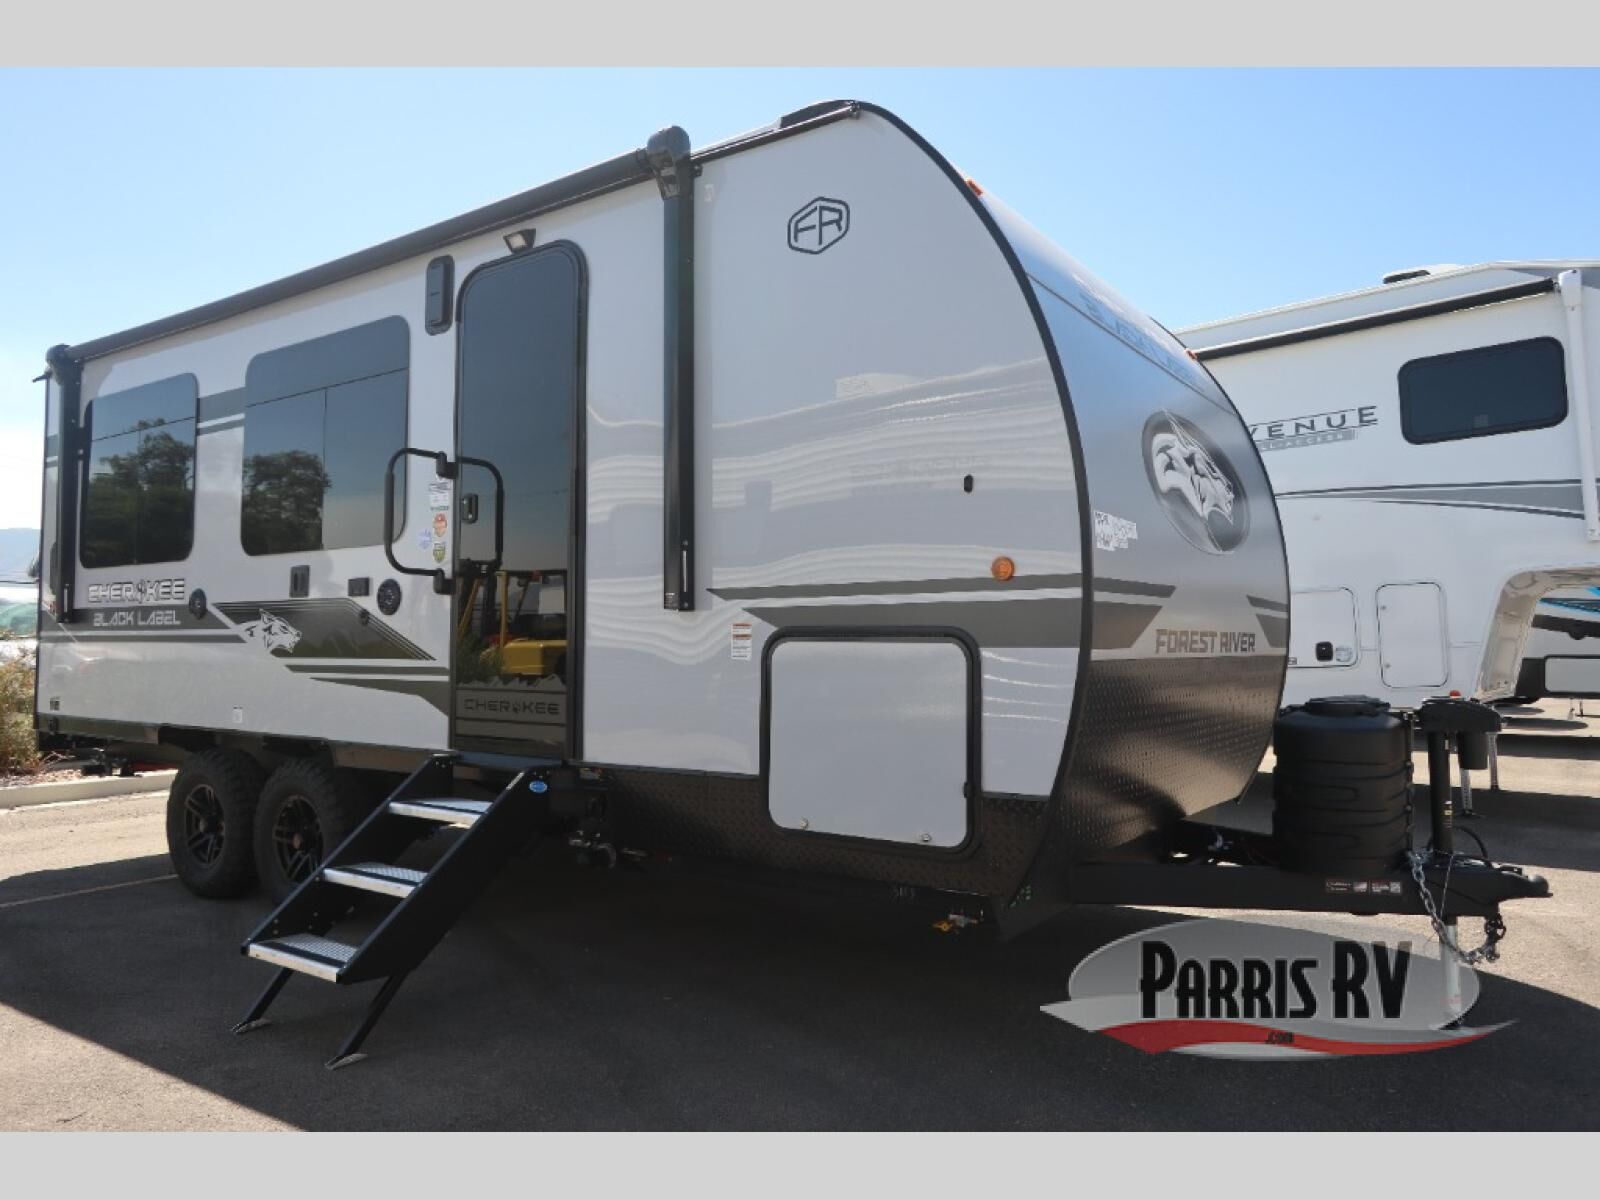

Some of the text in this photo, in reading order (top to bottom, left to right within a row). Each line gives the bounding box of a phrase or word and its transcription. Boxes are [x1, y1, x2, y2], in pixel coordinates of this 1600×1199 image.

[93, 610, 181, 627] BLACK LABEL
[1155, 628, 1256, 655] FOREST RIVER
[463, 698, 561, 716] CHEROKEE
